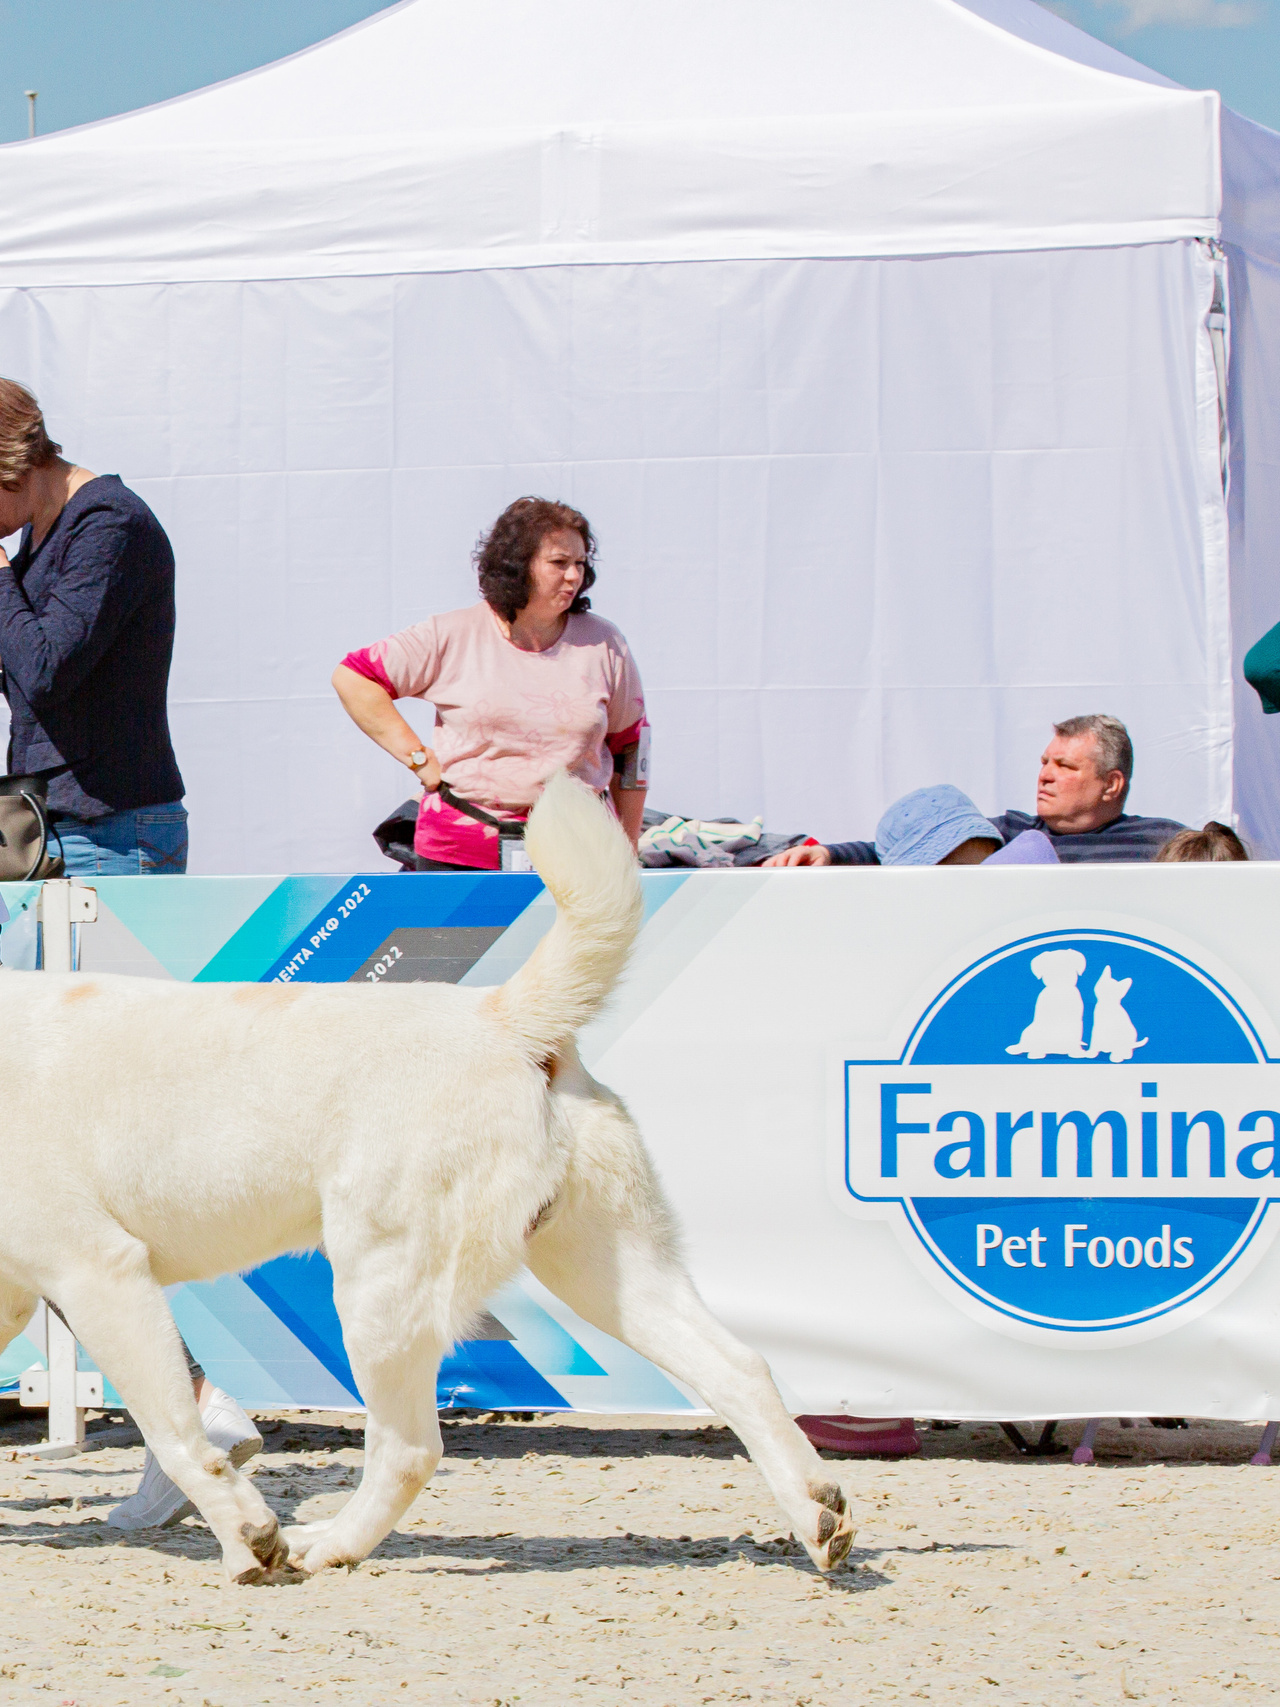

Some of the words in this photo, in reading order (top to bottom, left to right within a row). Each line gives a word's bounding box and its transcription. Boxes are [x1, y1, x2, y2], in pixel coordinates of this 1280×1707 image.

[310, 917, 340, 949] РКФ
[338, 883, 371, 918] 2022
[366, 946, 403, 982] 2022
[880, 1082, 1280, 1180] Farmina
[976, 1224, 1047, 1268] Pet
[1064, 1224, 1195, 1269] Foods
